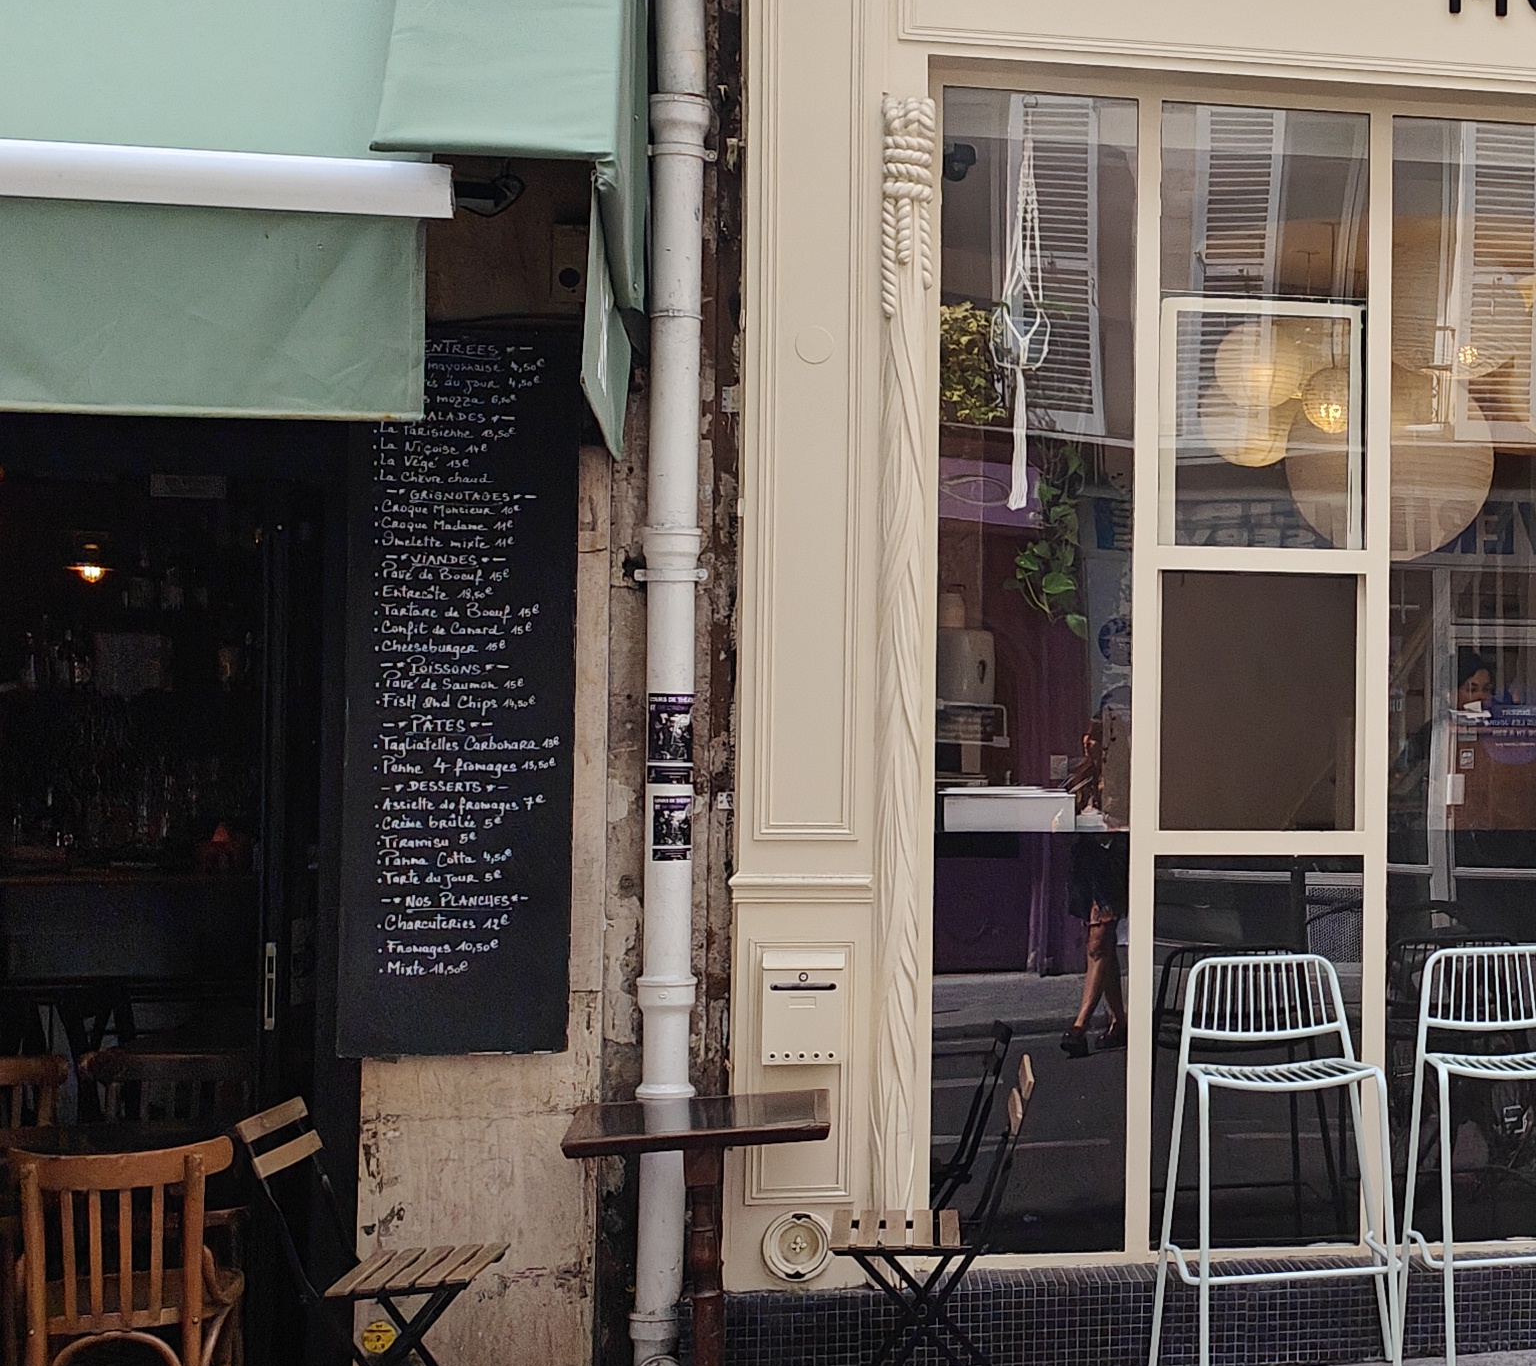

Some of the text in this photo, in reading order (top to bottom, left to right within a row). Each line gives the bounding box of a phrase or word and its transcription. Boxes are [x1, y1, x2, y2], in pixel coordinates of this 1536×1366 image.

[437, 395, 485, 407] mozza
[380, 422, 398, 433] La
[381, 437, 398, 449] La
[381, 453, 395, 465] La
[380, 469, 397, 481] La
[448, 473, 494, 483] chaud
[381, 499, 428, 517] Croque
[501, 504, 521, 515] 10€
[381, 516, 428, 532] Croque
[434, 521, 488, 531] Madame
[382, 530, 443, 547] Omelette
[450, 535, 490, 549] mixte
[382, 561, 413, 580] Pavé
[419, 571, 433, 580] de
[489, 569, 511, 581] 15€
[381, 601, 438, 617] Tartare
[444, 607, 460, 617] de
[518, 604, 540, 617] 15€
[381, 620, 532, 641] Confit de Canard 15€
[381, 639, 506, 659] Cheeseburger 15€
[383, 670, 525, 690] Pavé de Saumon 15€
[457, 696, 498, 716] Chips
[464, 735, 540, 751] Carbonara
[381, 755, 423, 774] Penne
[433, 757, 451, 773] 4
[454, 758, 517, 778] fromages
[406, 781, 482, 792] DESSERTS
[382, 794, 546, 816] Assiette de fromages 7€
[381, 813, 502, 830] Crème brûlée 5€
[381, 832, 477, 848] Tiramisu 5€
[379, 849, 512, 867] Panna Cotta 4,50€
[383, 869, 420, 885] Tarte
[425, 871, 441, 883] du
[484, 870, 502, 881] 5€
[405, 892, 510, 907] NOS PLANCHES
[385, 914, 510, 931] Charcuteries 12€
[387, 938, 499, 959] Fromages 10,50€
[387, 960, 426, 976] Mixte
